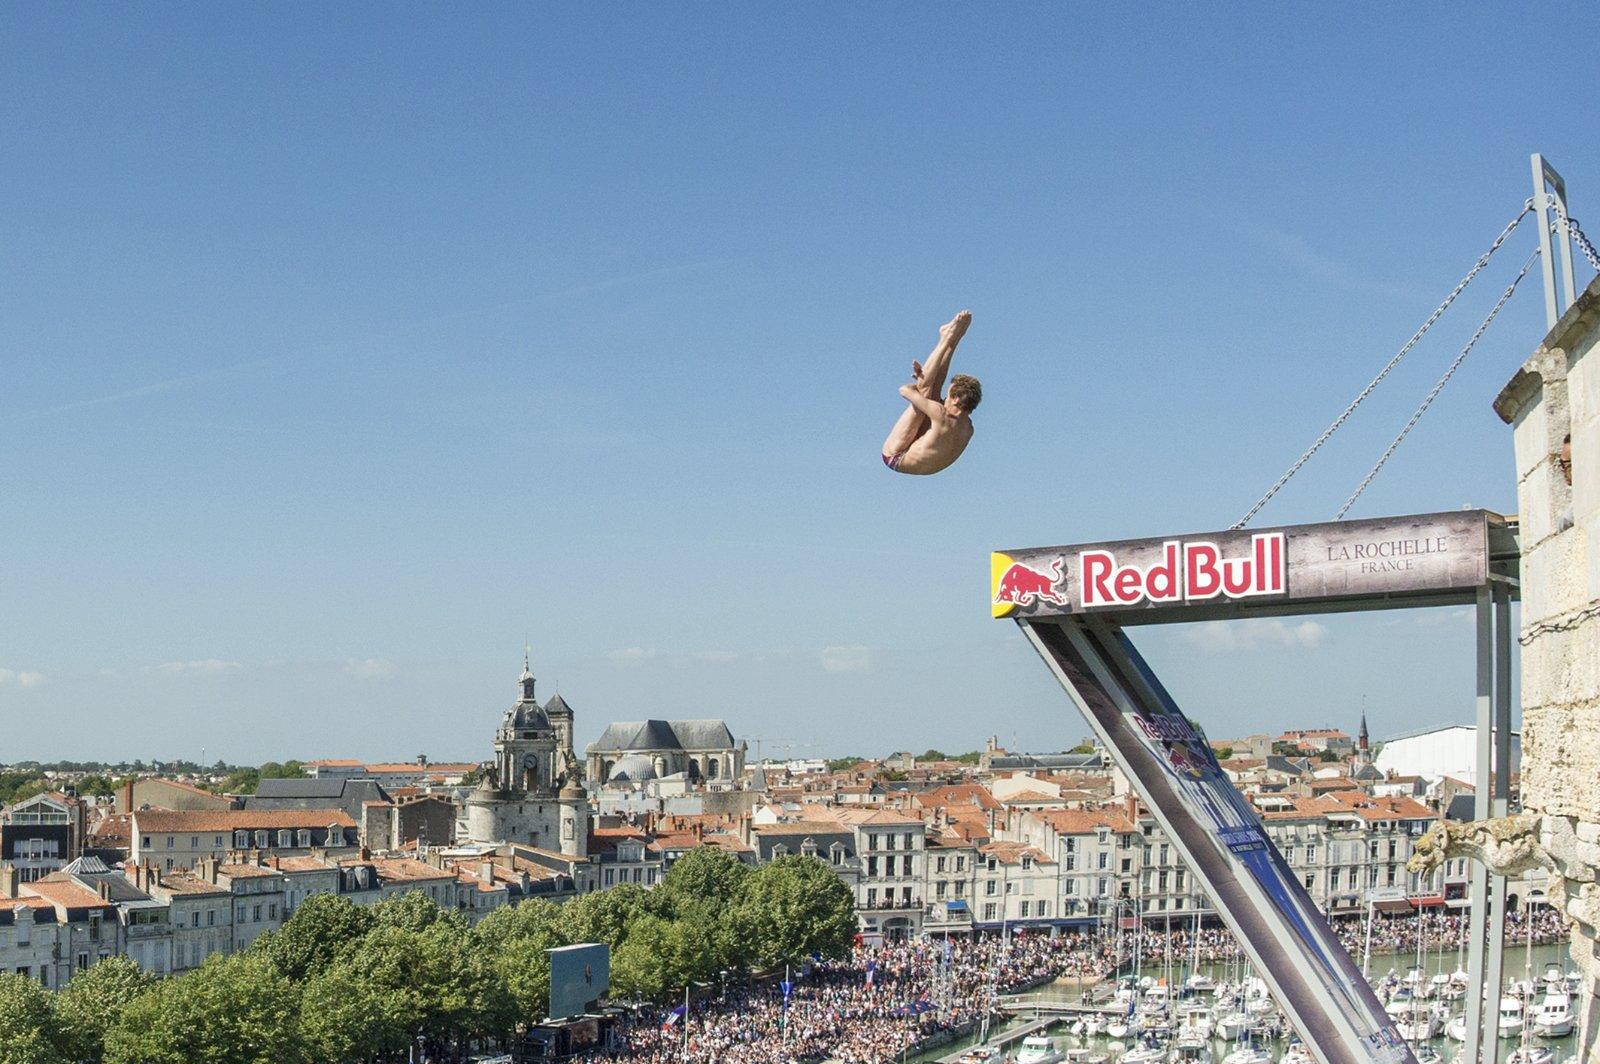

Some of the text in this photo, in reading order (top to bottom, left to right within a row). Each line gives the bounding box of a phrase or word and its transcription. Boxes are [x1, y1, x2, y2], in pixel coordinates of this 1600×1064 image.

[1327, 537, 1448, 561] LA ROCHELLE
[1080, 533, 1286, 606] Red Bull
[1361, 559, 1414, 573] FRANCE
